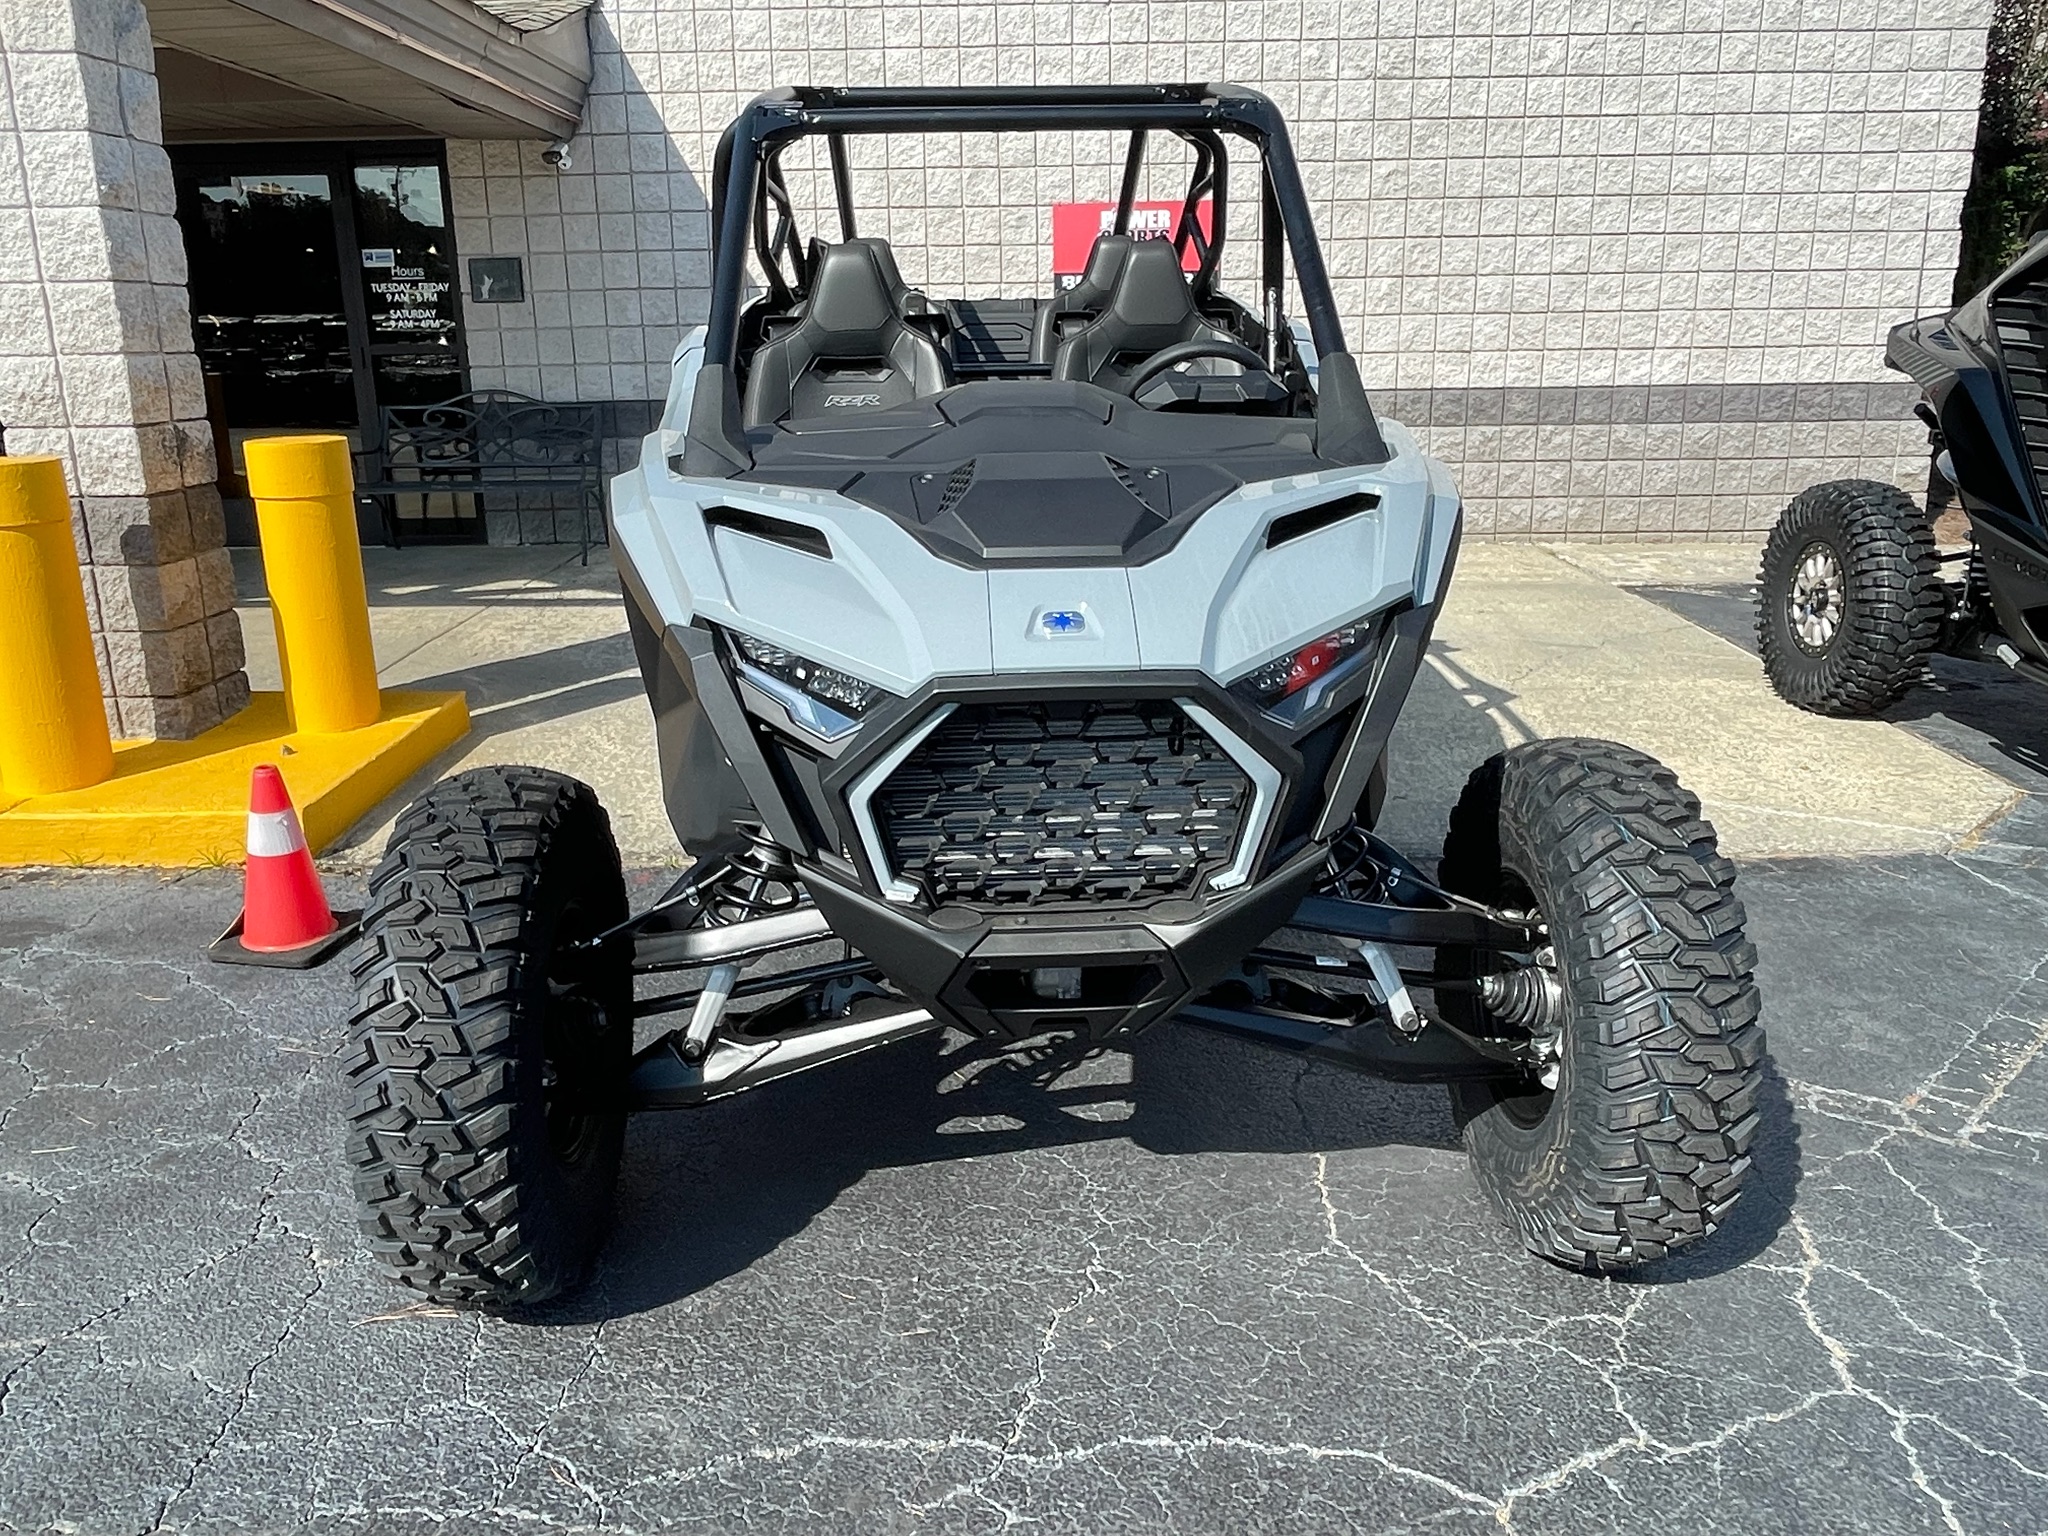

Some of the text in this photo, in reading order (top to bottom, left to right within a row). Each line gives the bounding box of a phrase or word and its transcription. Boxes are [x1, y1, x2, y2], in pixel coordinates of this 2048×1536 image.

[1100, 209, 1171, 228] PWER
[391, 265, 424, 276] Hours
[371, 282, 411, 293] TUESDAY
[418, 282, 450, 293] FRIDAY
[390, 309, 437, 319] SATURDAY
[824, 394, 880, 407] RZR
